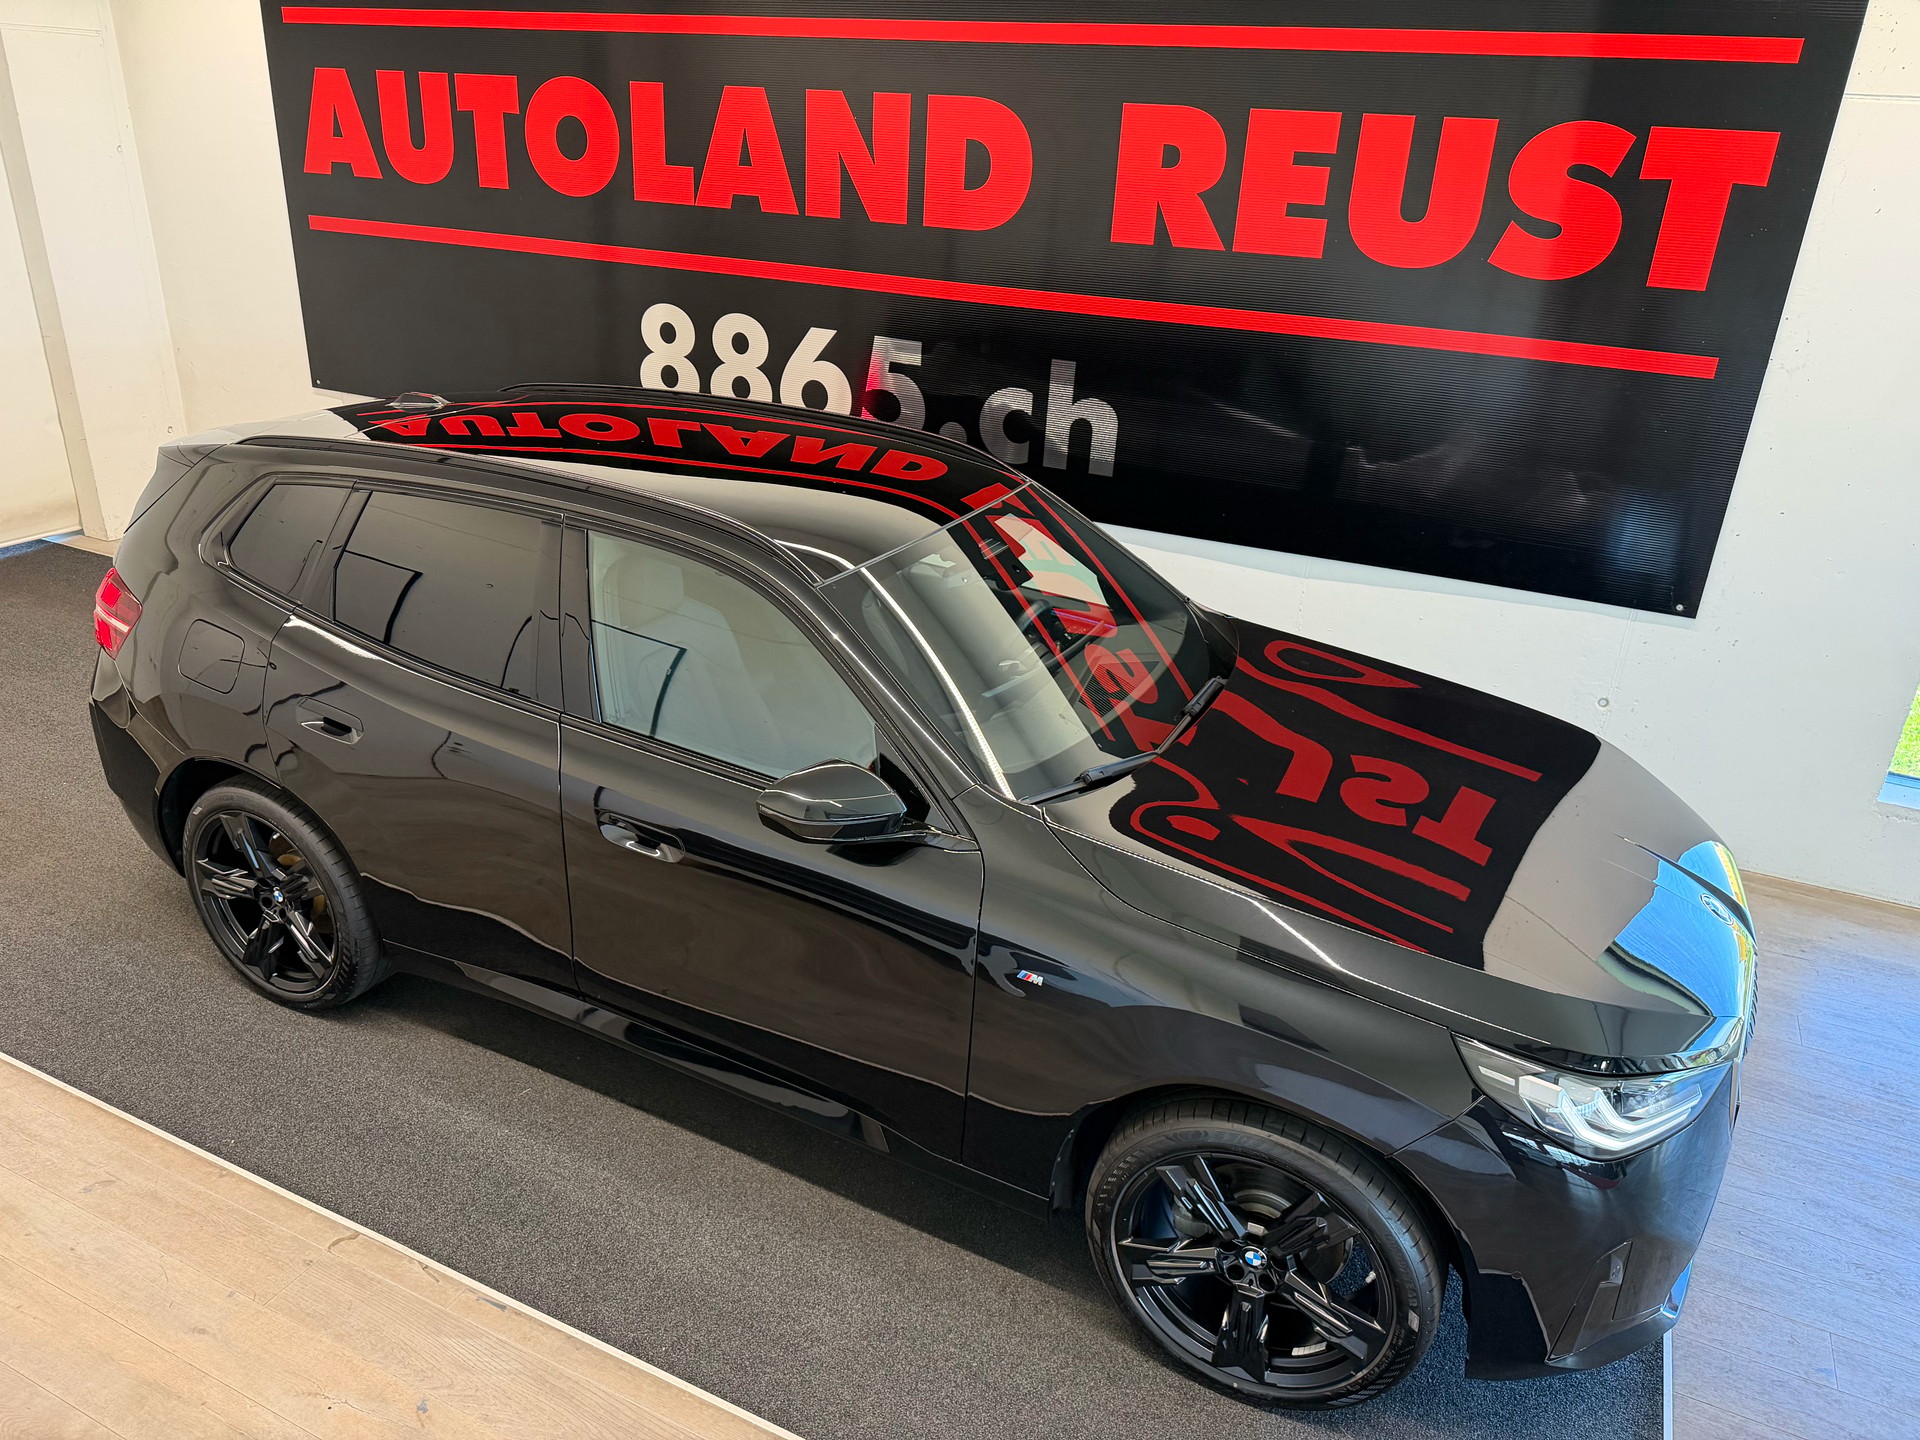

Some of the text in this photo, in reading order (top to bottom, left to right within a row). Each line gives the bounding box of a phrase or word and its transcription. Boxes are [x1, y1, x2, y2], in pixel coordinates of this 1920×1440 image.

[303, 68, 1781, 292] AUTOLAND REUST
[639, 303, 1120, 478] 8865.ch
